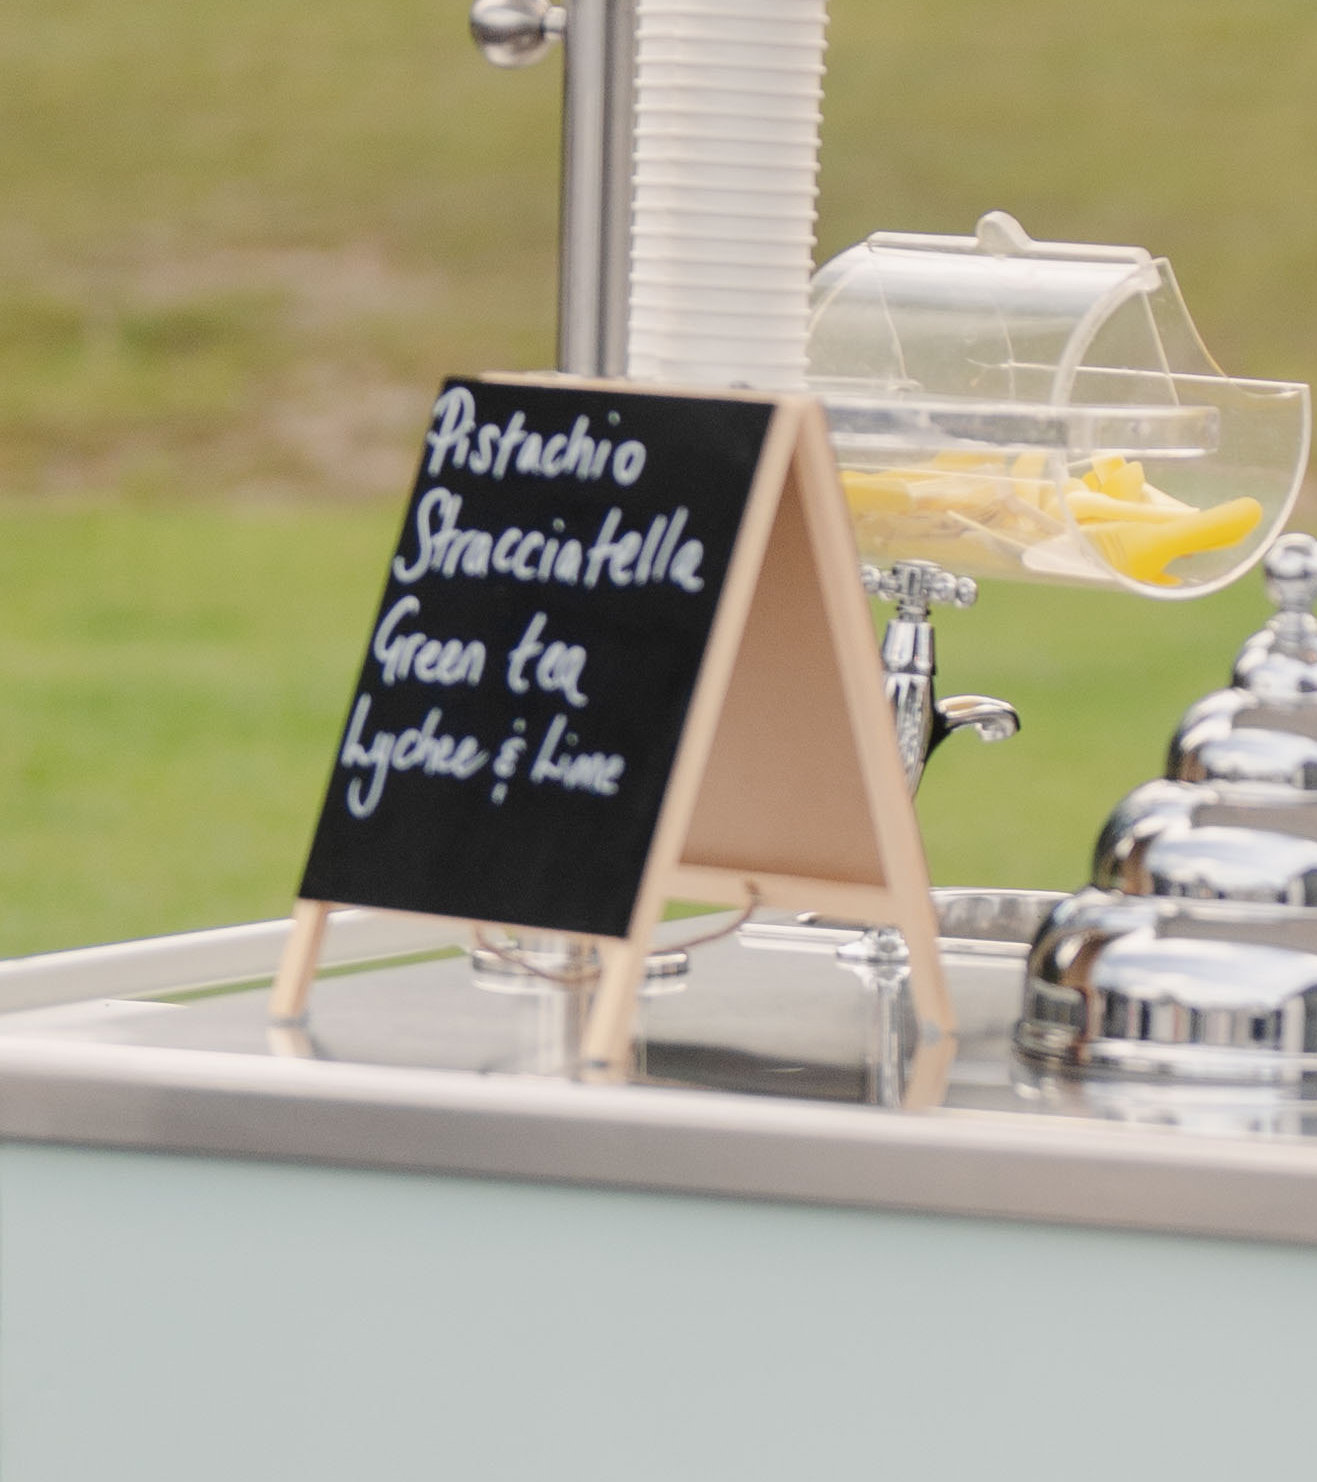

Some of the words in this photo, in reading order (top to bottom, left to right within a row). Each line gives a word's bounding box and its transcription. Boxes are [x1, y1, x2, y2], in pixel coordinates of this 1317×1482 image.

[426, 386, 647, 486] Pistachio
[393, 486, 705, 592] Stracciatella
[373, 594, 487, 687] Green
[506, 610, 589, 708] tea
[341, 691, 490, 819] Lychee
[530, 712, 626, 796] Lime
